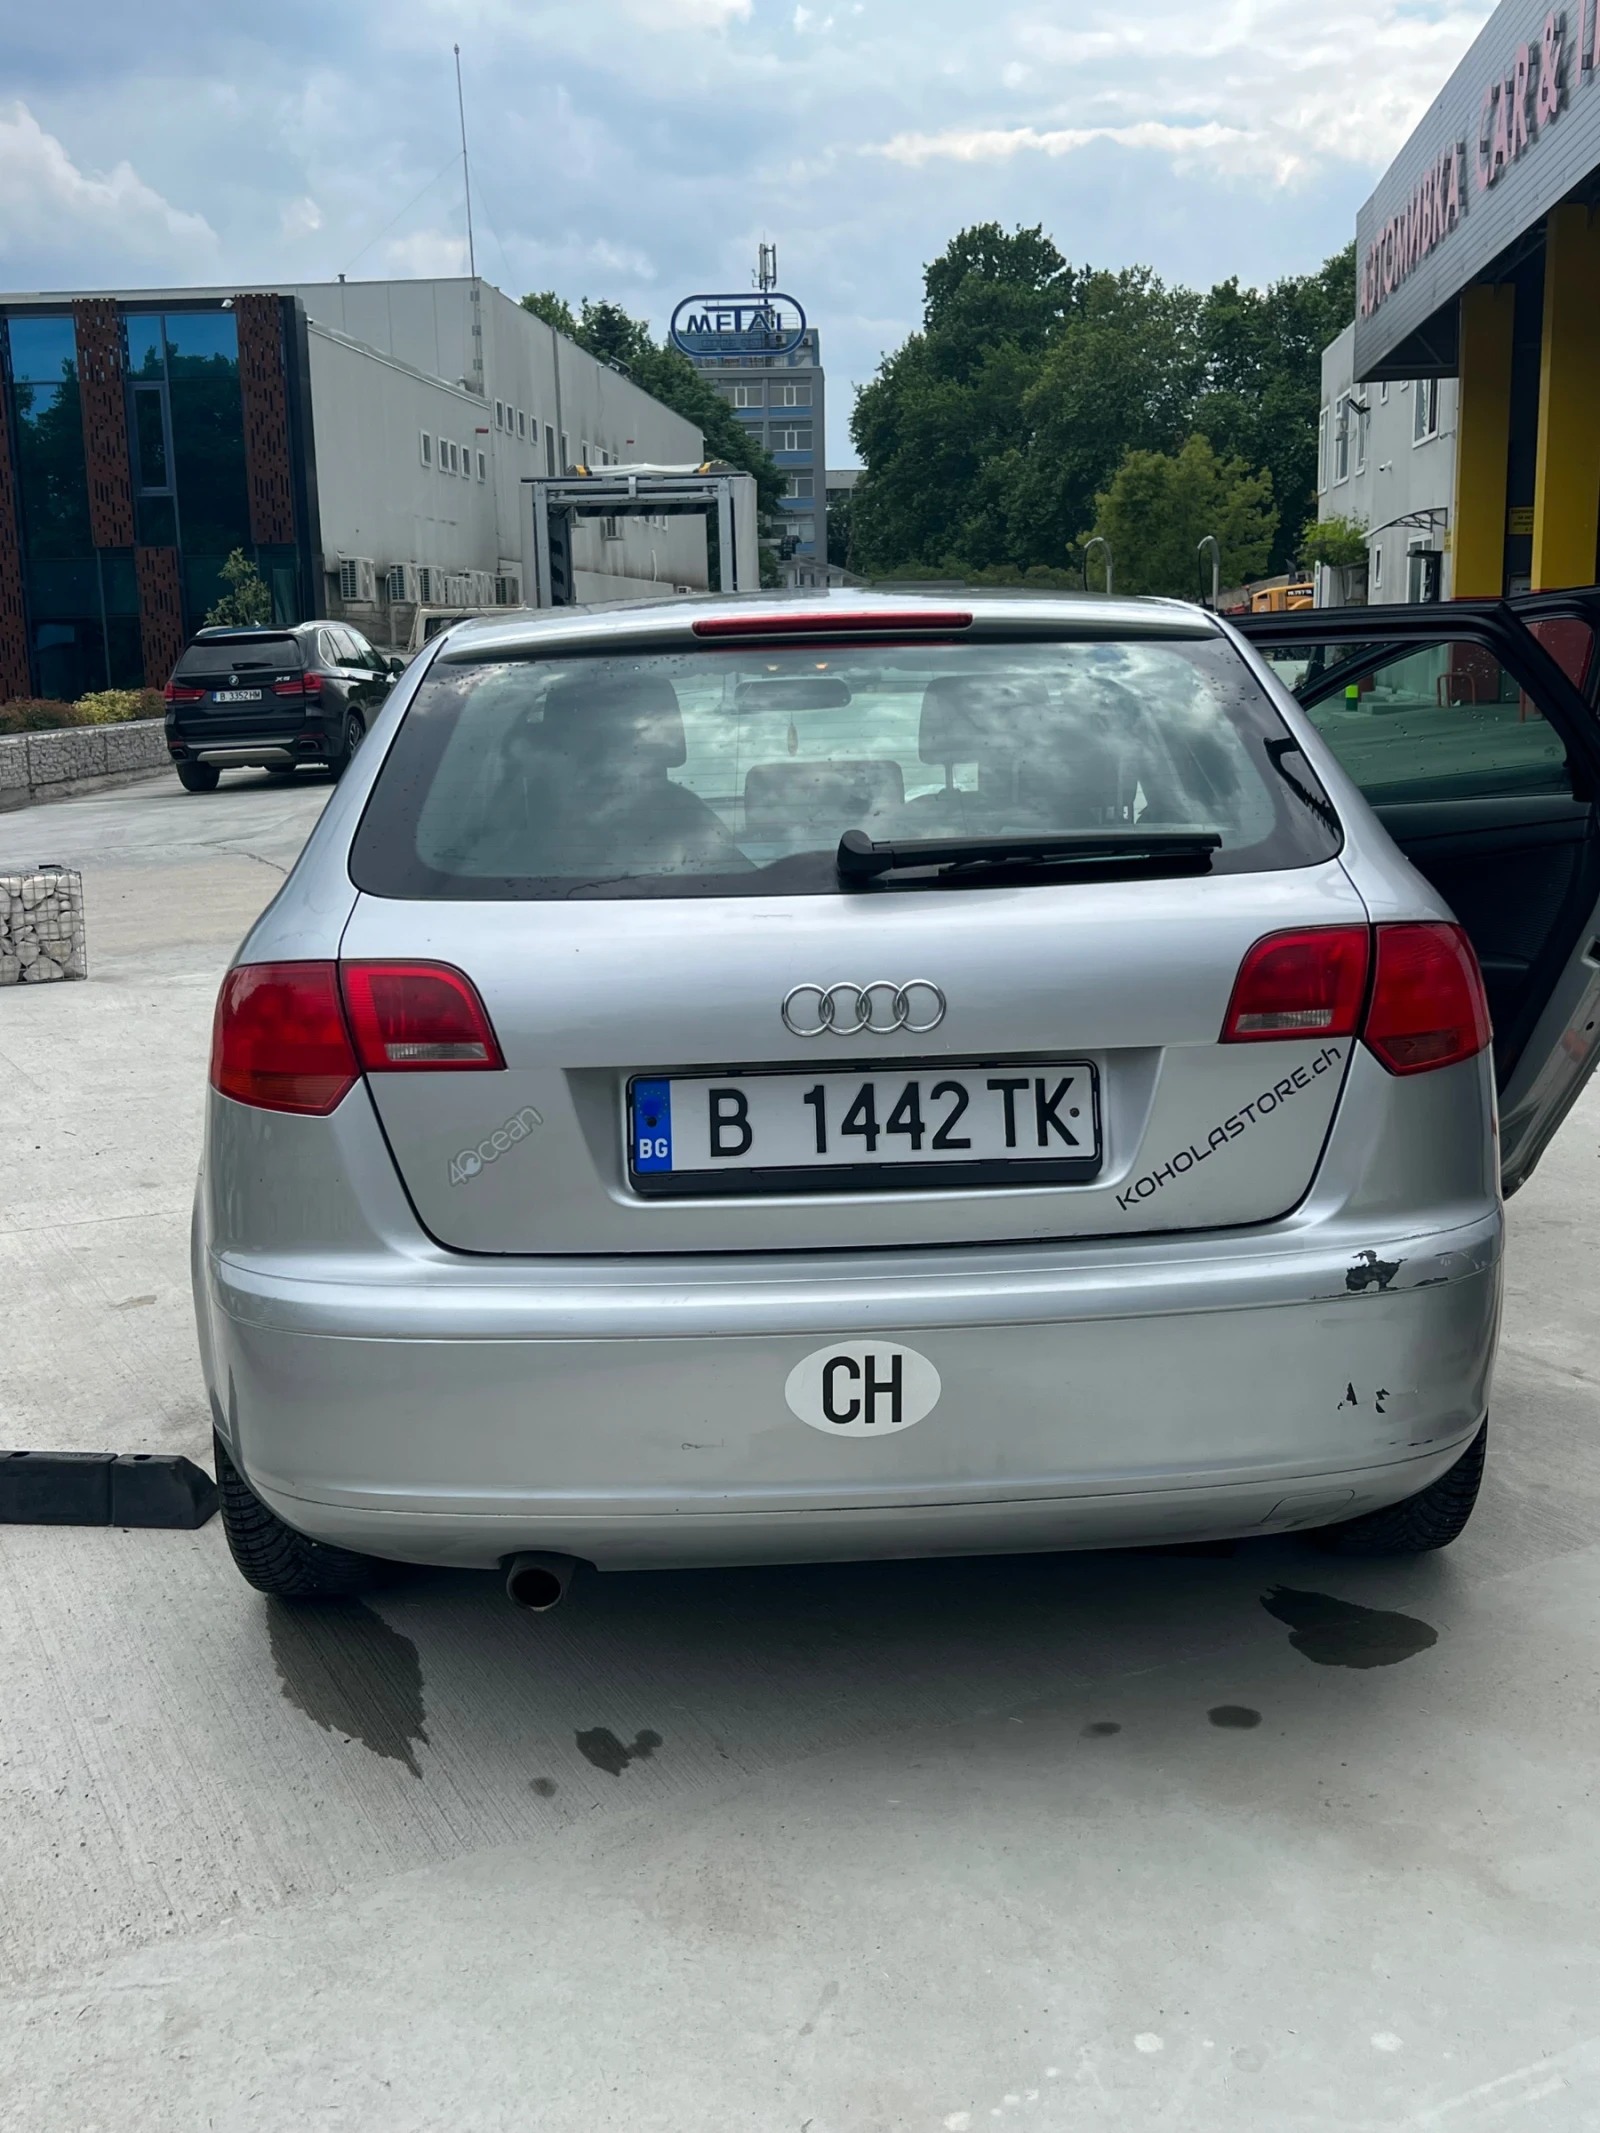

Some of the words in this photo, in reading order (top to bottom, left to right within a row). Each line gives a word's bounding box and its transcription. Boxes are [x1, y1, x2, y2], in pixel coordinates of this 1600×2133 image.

[1360, 142, 1459, 318] АВТОМИВКА
[1476, 41, 1529, 192] CAR
[1537, 9, 1562, 126] &
[686, 304, 792, 334] METAL
[220, 692, 226, 701] B
[229, 691, 249, 700] 3352
[639, 1137, 668, 1159] BG
[708, 1088, 753, 1158] B
[803, 1081, 972, 1153] 1442
[986, 1077, 1080, 1147] TK
[1115, 1046, 1342, 1211] KOHOLASTORE.ch
[822, 1354, 903, 1425] CH
